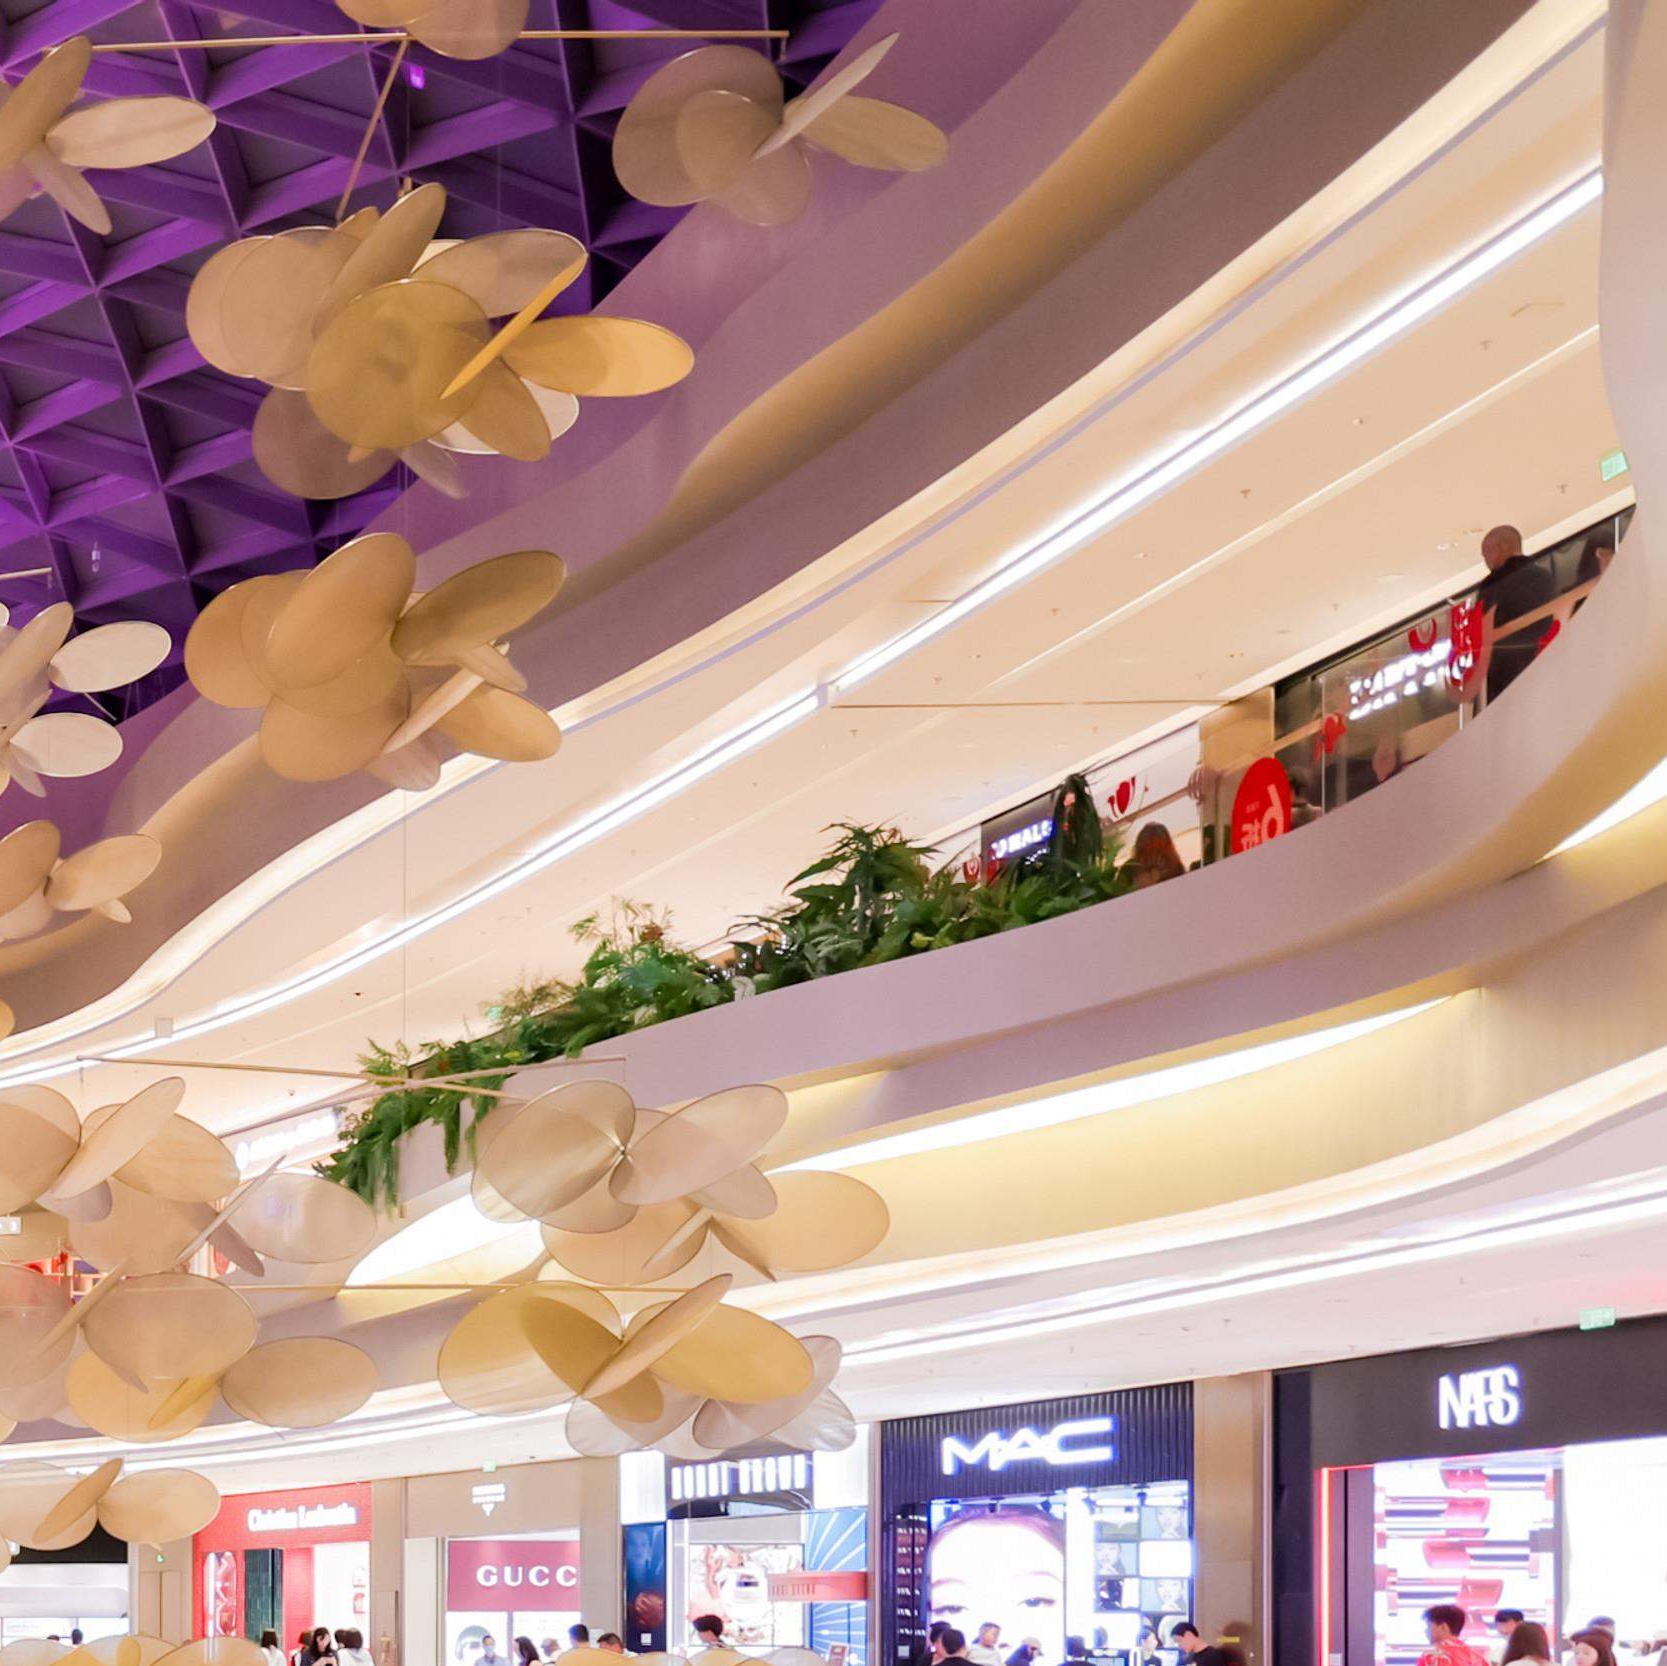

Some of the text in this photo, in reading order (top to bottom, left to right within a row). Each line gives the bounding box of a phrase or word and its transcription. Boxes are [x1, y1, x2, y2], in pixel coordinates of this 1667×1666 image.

[1438, 1366, 1519, 1430] NARS
[942, 1417, 1116, 1475] MAC
[476, 1564, 578, 1587] GUCC
